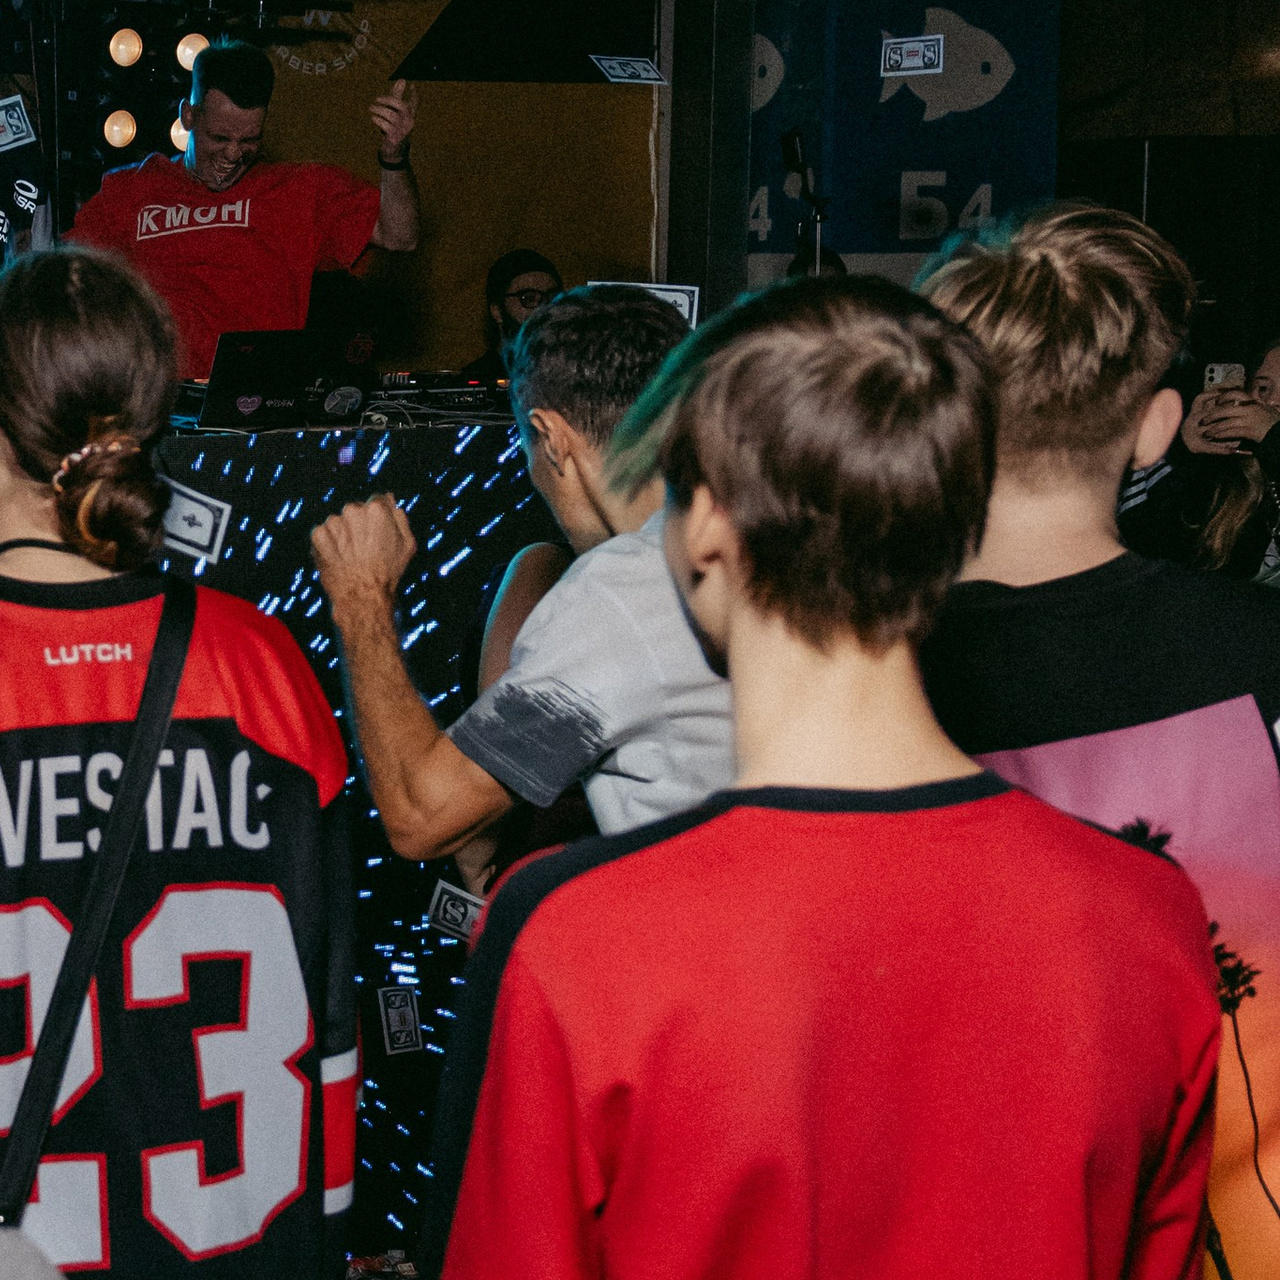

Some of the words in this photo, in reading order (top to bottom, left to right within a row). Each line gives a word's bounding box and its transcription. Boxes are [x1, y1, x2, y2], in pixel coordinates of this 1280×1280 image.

[276, 46, 327, 76] RBER
[333, 18, 372, 72] SHOP
[44, 642, 133, 666] LUTCH
